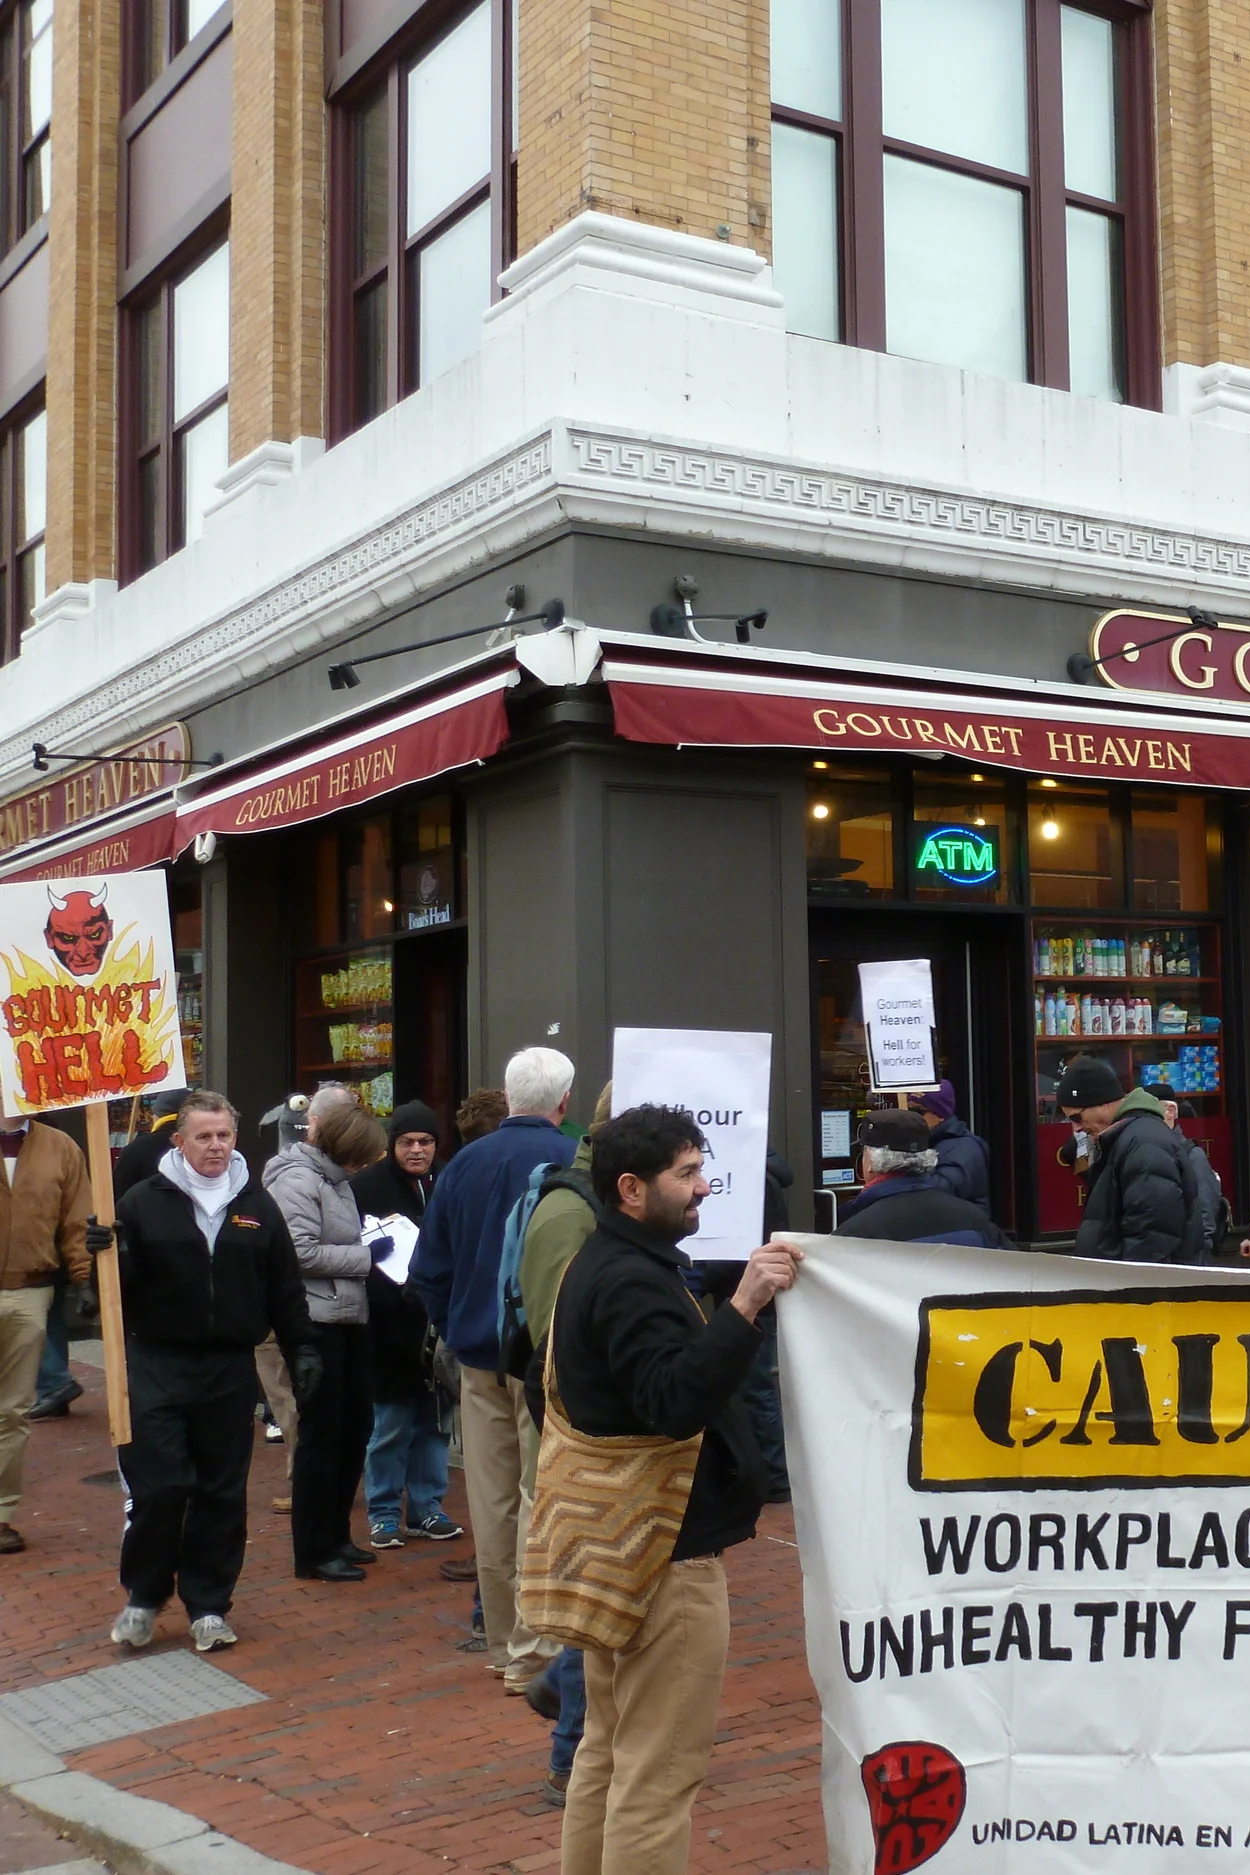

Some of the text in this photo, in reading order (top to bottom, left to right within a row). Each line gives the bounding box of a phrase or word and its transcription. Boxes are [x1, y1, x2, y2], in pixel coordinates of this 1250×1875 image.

[812, 708, 1193, 772] GOURMET HEAVEN
[0, 741, 166, 850] MET HEAVEN
[235, 744, 398, 826] GOURMET HEAVEN
[86, 838, 130, 876] HEAVEN
[916, 839, 994, 872] ATM
[877, 998, 922, 1010] Gourmet
[882, 1054, 927, 1067] workers!
[883, 1038, 922, 1051] Hell for
[17, 1029, 169, 1105] HELL
[838, 1599, 1196, 1684] UNHEALTHY
[971, 1817, 1077, 1846] UNIDAD
[1088, 1820, 1184, 1846] LATINA
[1196, 1823, 1233, 1848] EN
